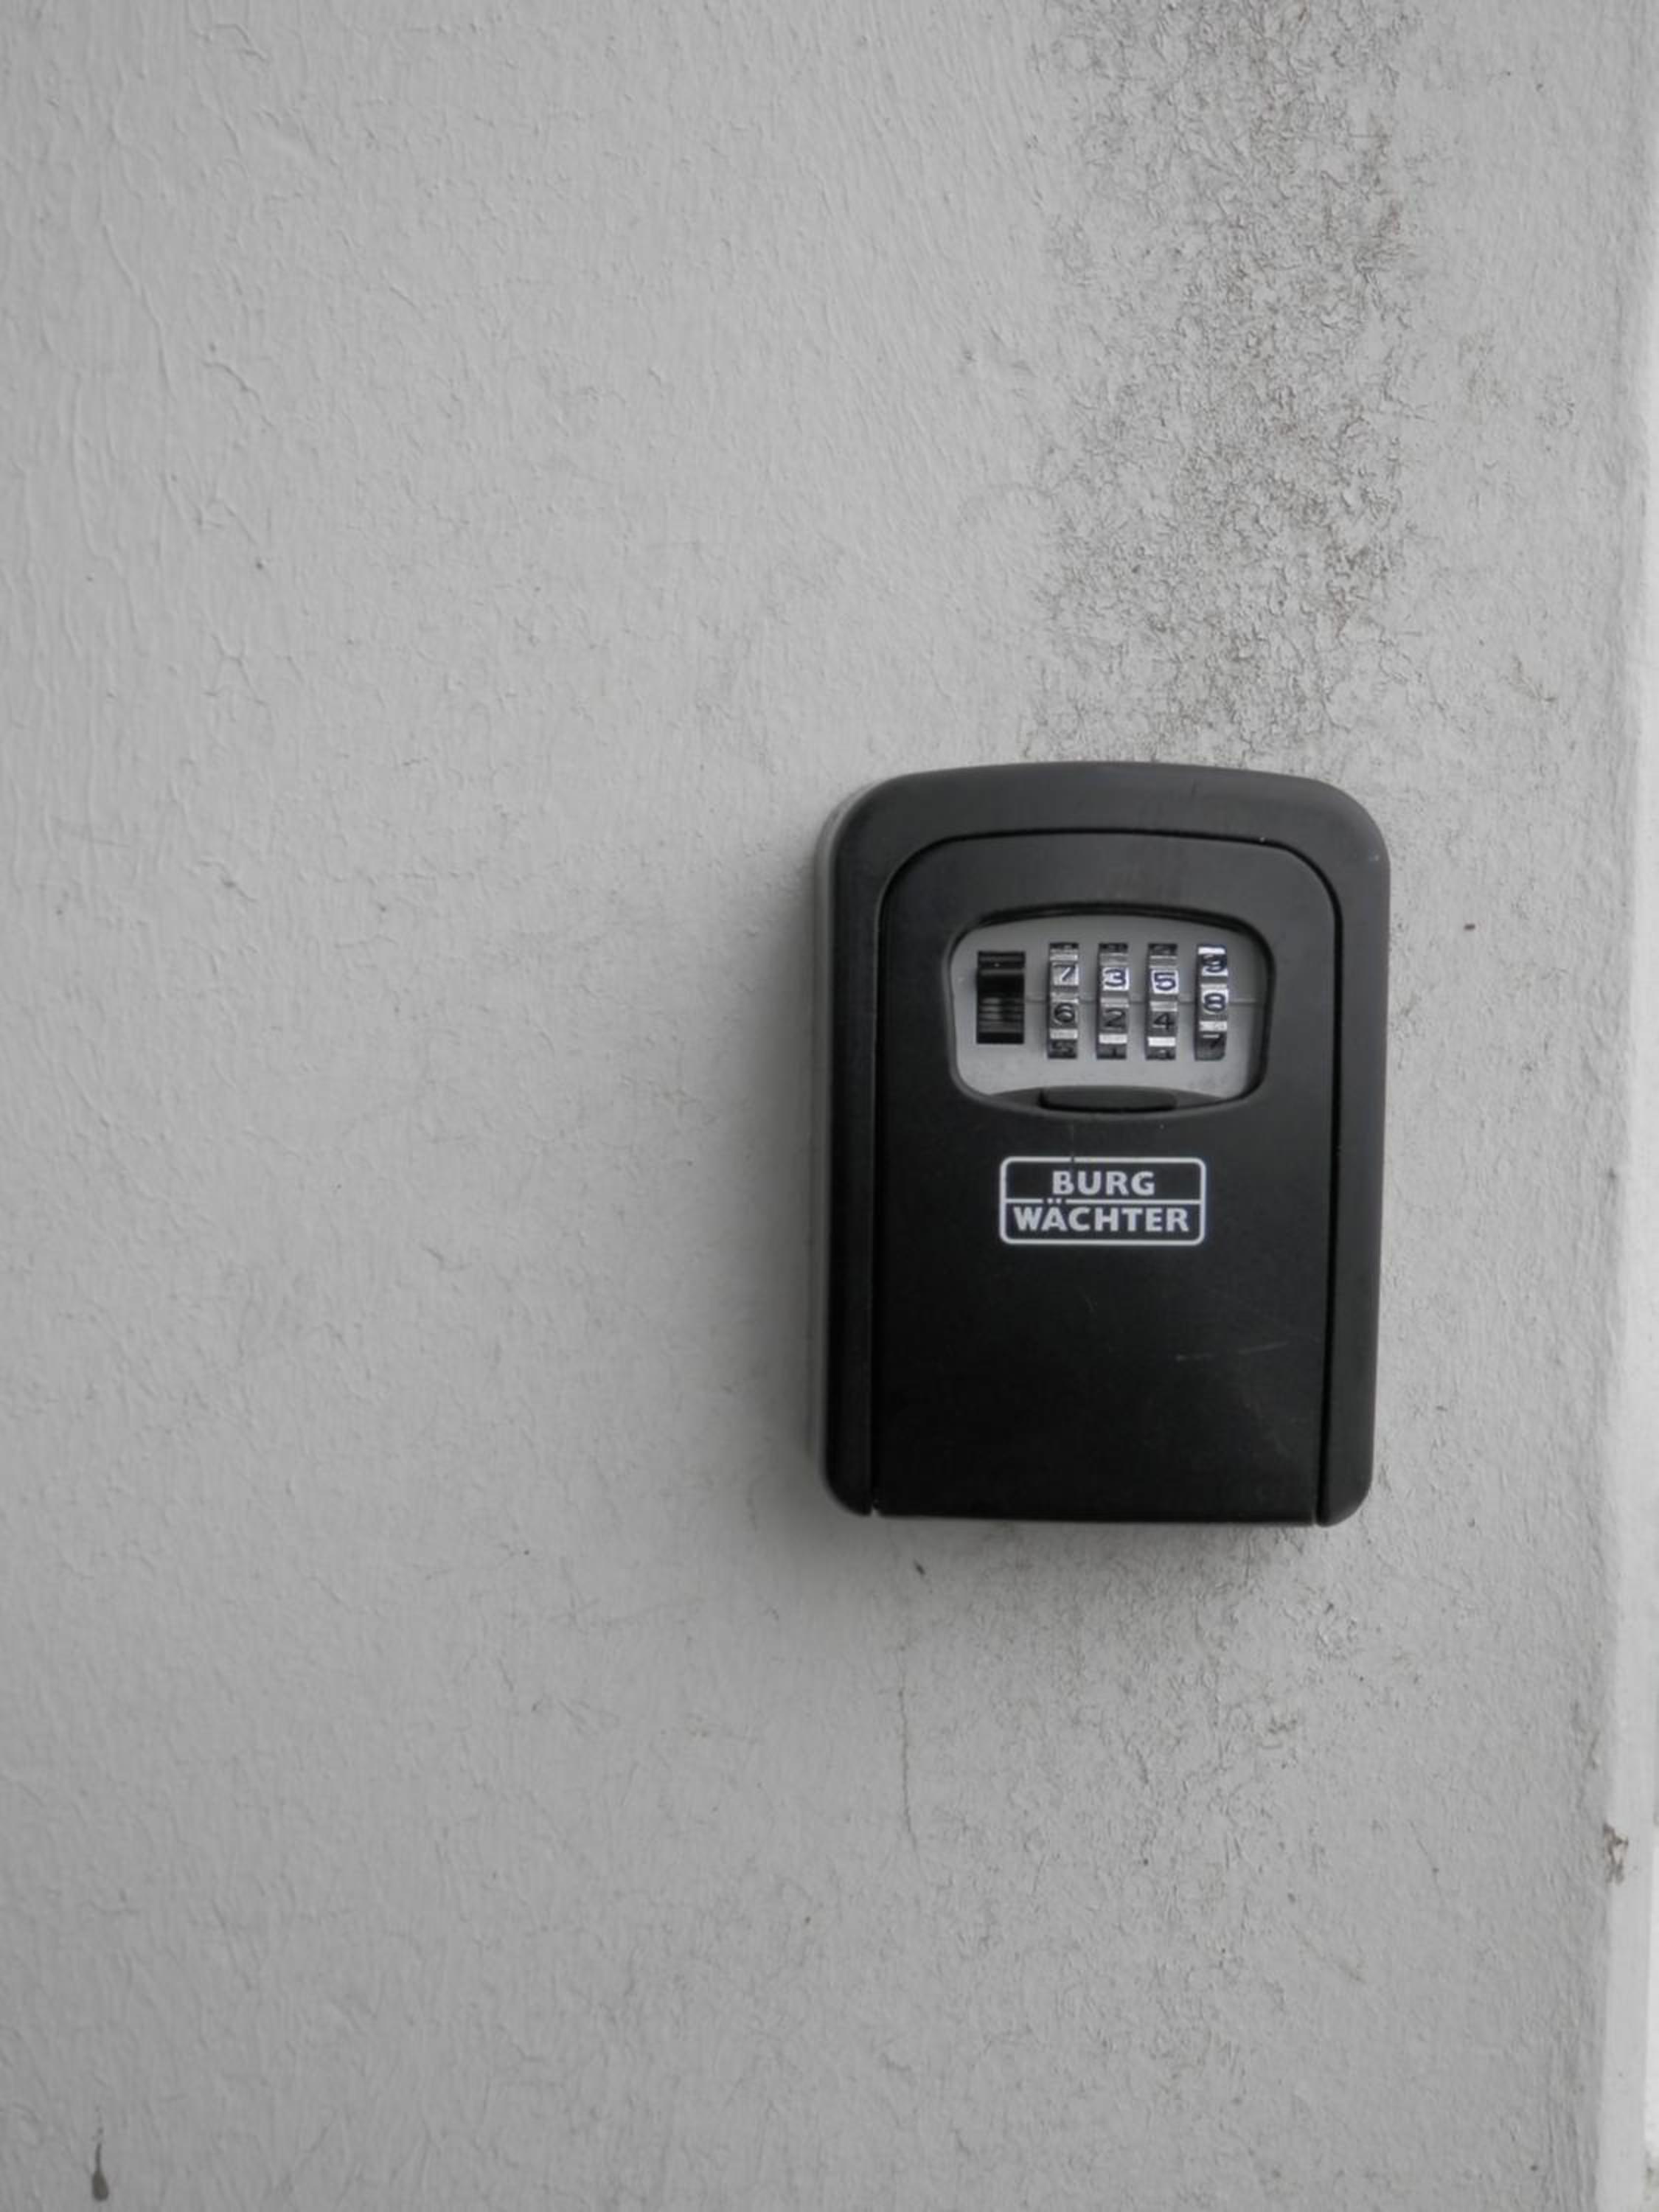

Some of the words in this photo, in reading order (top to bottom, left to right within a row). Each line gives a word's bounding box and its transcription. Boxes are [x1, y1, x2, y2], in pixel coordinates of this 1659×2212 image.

[1053, 963, 1076, 981] 7
[1105, 968, 1127, 987] 3
[1153, 972, 1177, 991] 5
[1054, 1002, 1076, 1023] 6
[1105, 1007, 1127, 1028] 2
[1152, 1012, 1175, 1031] 4
[1203, 992, 1226, 1012] 8
[1051, 1169, 1156, 1196] BURG
[1012, 1197, 1189, 1232] WÄCHTER
